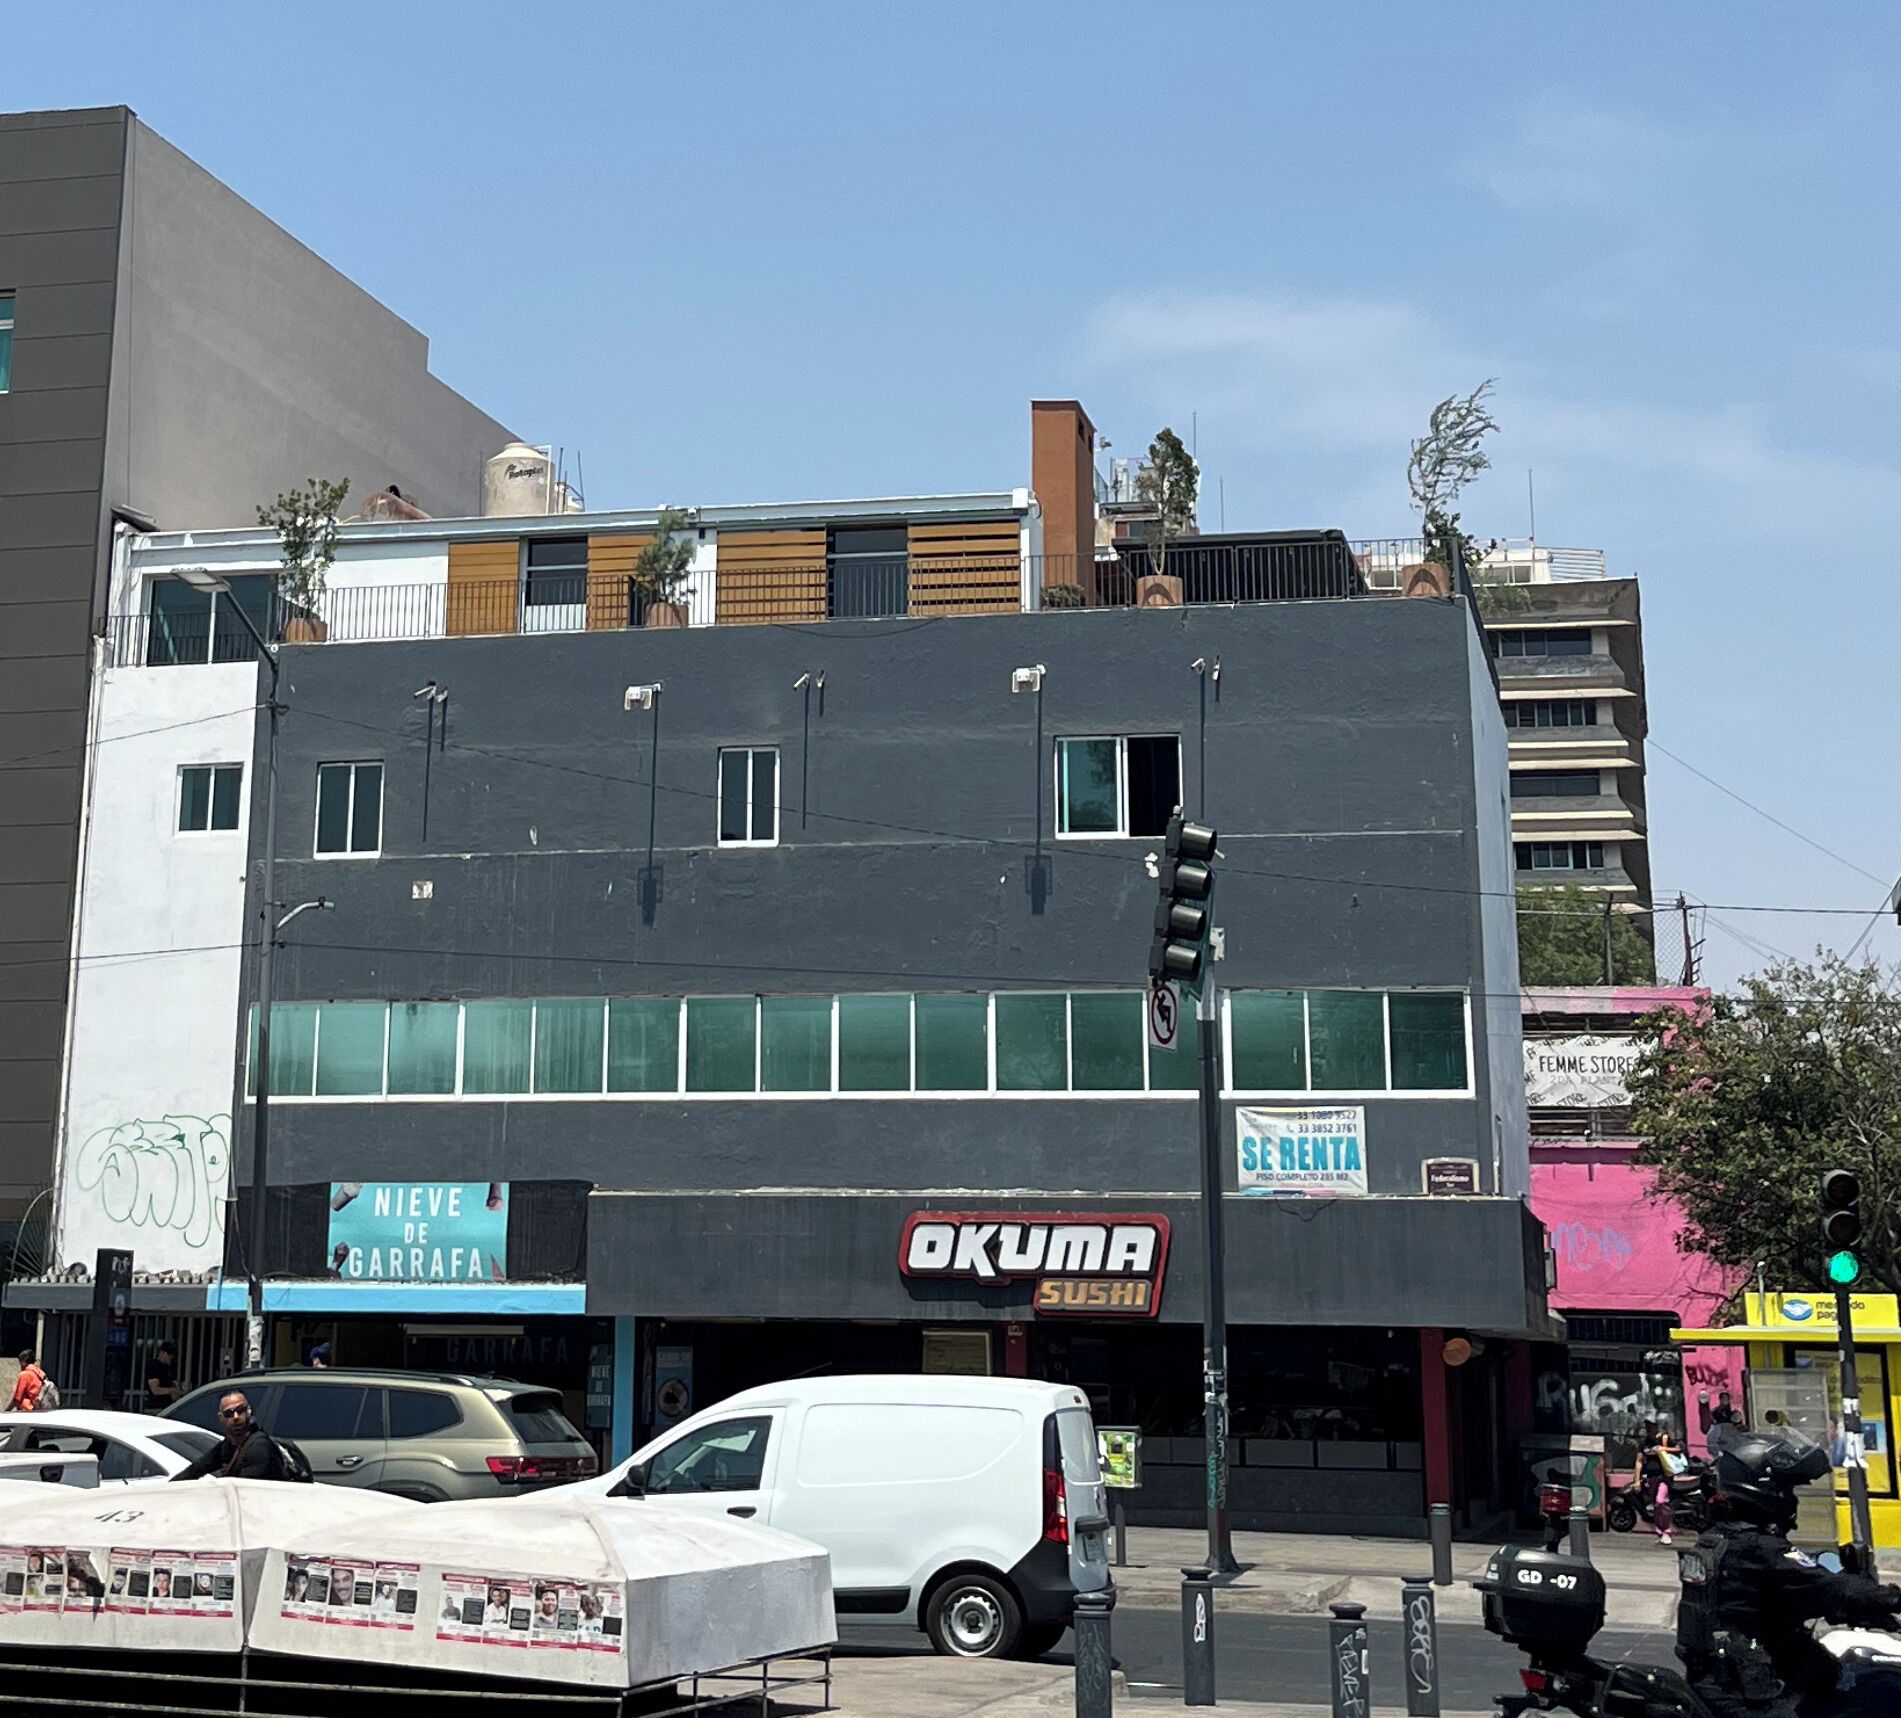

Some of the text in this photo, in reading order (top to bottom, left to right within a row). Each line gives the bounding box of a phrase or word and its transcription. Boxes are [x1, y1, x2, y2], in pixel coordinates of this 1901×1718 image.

[1539, 1055, 1588, 1073] FEMME
[1580, 1075, 1621, 1085] PLANT
[1297, 1123, 1309, 1134] 33
[1242, 1136, 1361, 1171] SE RENTA
[1256, 1172, 1274, 1181] PISO
[1276, 1172, 1319, 1181] COMPLETO
[374, 1187, 463, 1217] NIEVE
[404, 1222, 429, 1244] DE
[908, 1224, 1157, 1277] OKUMA
[349, 1247, 483, 1278] GARRAFA
[1039, 1281, 1147, 1306] SUSHI
[1816, 1311, 1838, 1321] pag
[447, 1337, 569, 1363] GARRAFA
[1517, 1569, 1577, 1589] GD -07
